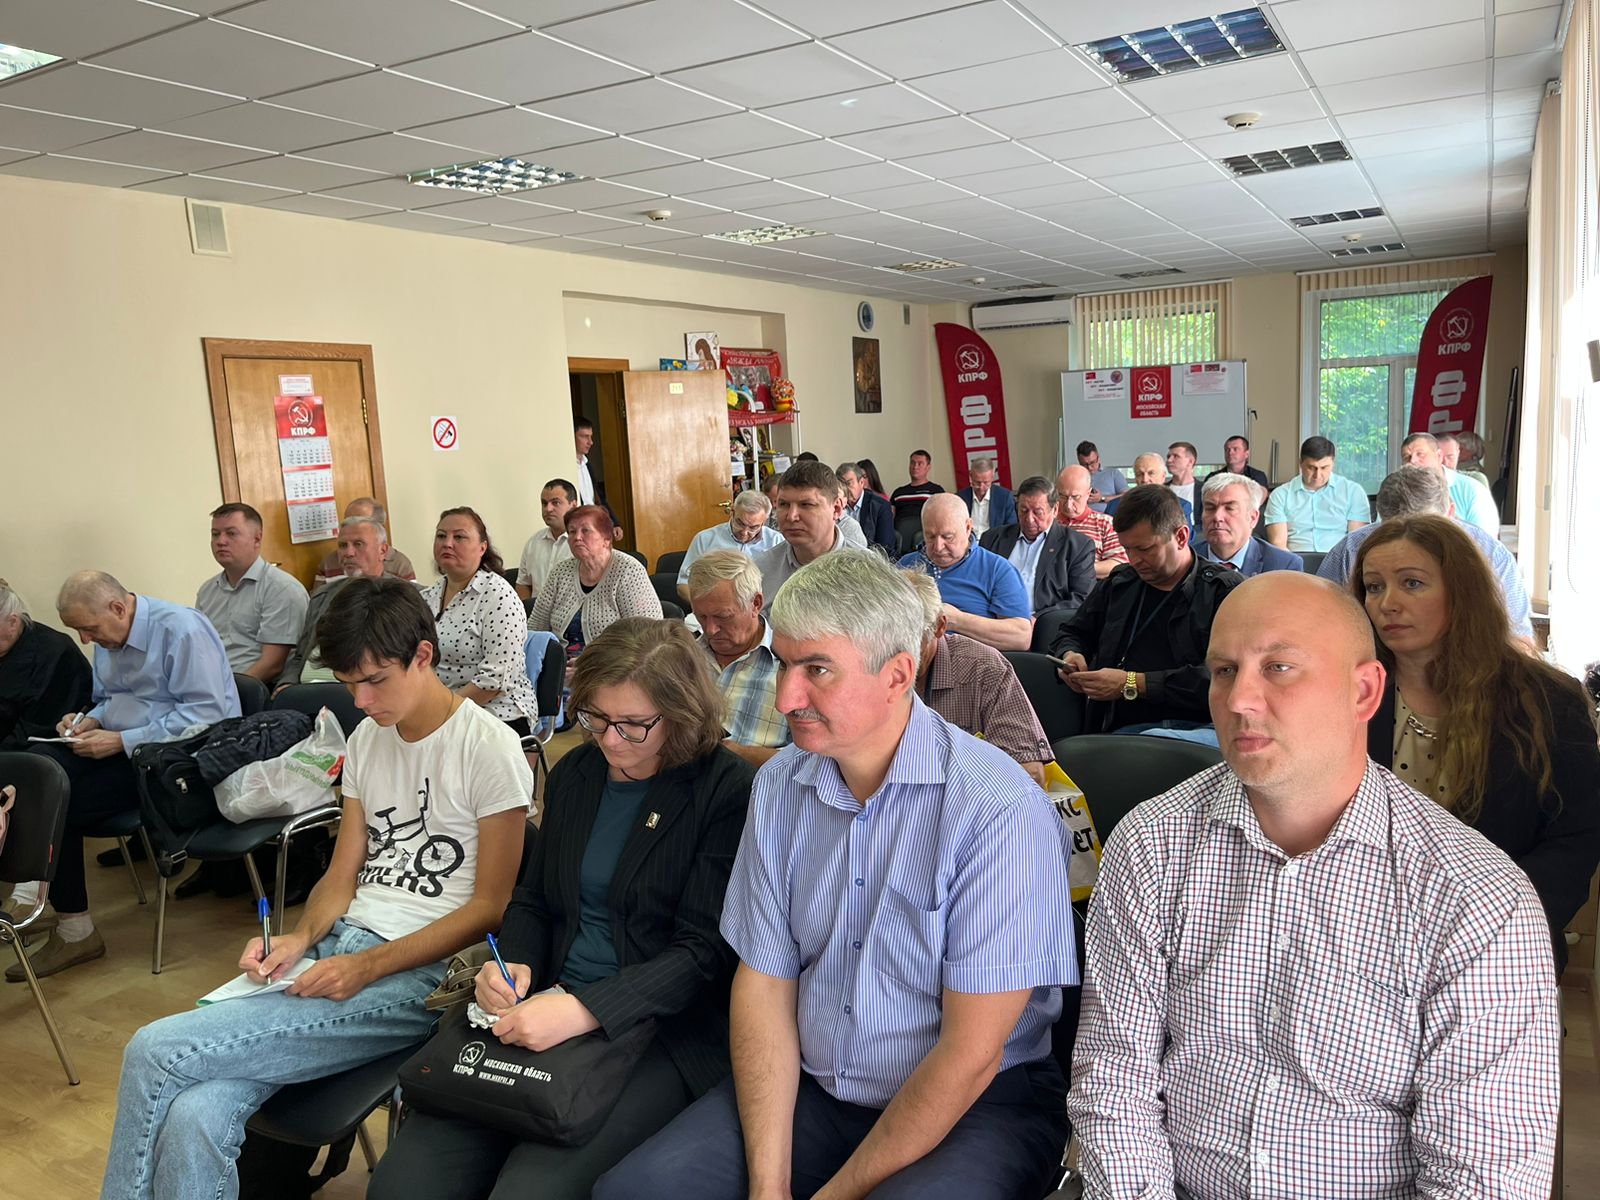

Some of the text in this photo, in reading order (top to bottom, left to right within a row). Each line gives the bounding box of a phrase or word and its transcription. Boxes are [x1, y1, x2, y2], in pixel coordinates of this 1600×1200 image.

[1438, 342, 1472, 356] КПРФ
[957, 371, 988, 383] КПРФ
[1138, 393, 1163, 402] КПРФ
[290, 427, 316, 438] КПРФ
[453, 1063, 475, 1076] КПРФ
